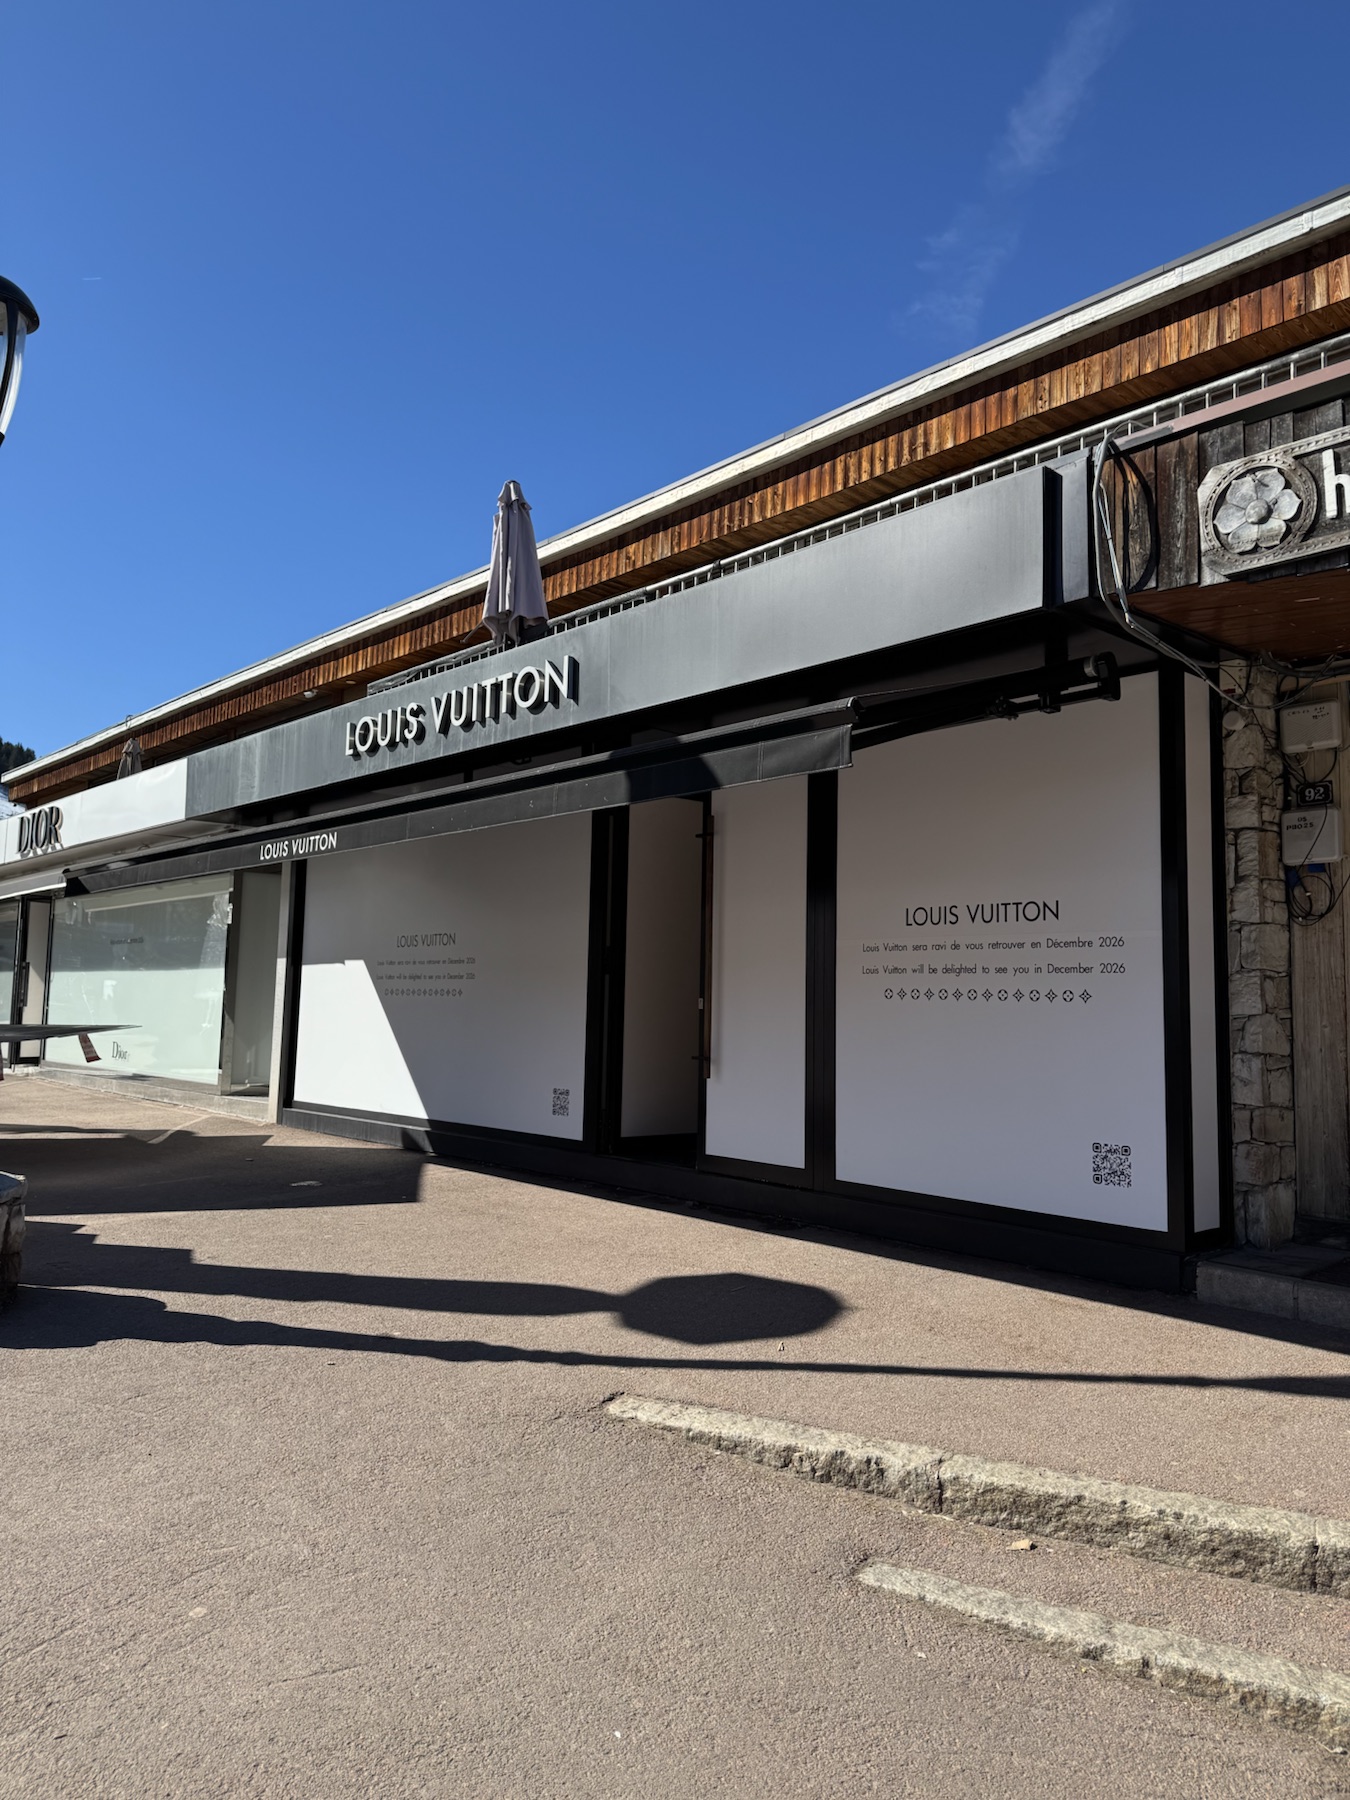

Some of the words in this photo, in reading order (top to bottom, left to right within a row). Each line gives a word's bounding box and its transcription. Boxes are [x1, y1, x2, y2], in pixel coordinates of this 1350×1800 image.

[345, 702, 424, 758] LOUIS
[430, 655, 577, 736] VUITTON
[1304, 786, 1325, 802] 92
[16, 806, 63, 854] DIOR
[260, 840, 289, 860] LOUIS
[292, 831, 337, 856] VUITTON
[905, 905, 959, 927] LOUIS
[966, 900, 1060, 923] VUITTON
[396, 934, 419, 948] LOUIS
[420, 932, 456, 947] VUITTON
[862, 943, 880, 953] Louis
[883, 942, 907, 952] Vuitton
[912, 943, 928, 951] sera
[931, 941, 947, 950] ravi
[950, 940, 961, 950] de
[965, 942, 984, 950] vous
[988, 941, 1026, 950] retrouver
[1030, 941, 1042, 949] en
[1046, 936, 1093, 949] Décembre
[1098, 936, 1125, 948] 2026
[862, 965, 880, 975] Louis
[882, 964, 907, 974] Vuitton
[911, 964, 924, 974] will
[928, 963, 938, 974] be
[941, 963, 977, 977] delighted
[982, 965, 990, 974] to
[994, 966, 1008, 974] see
[1012, 966, 1029, 977] you
[1034, 963, 1042, 974] in
[1047, 962, 1094, 974] December
[1099, 962, 1126, 974] 2026
[111, 1041, 128, 1060] Dior
